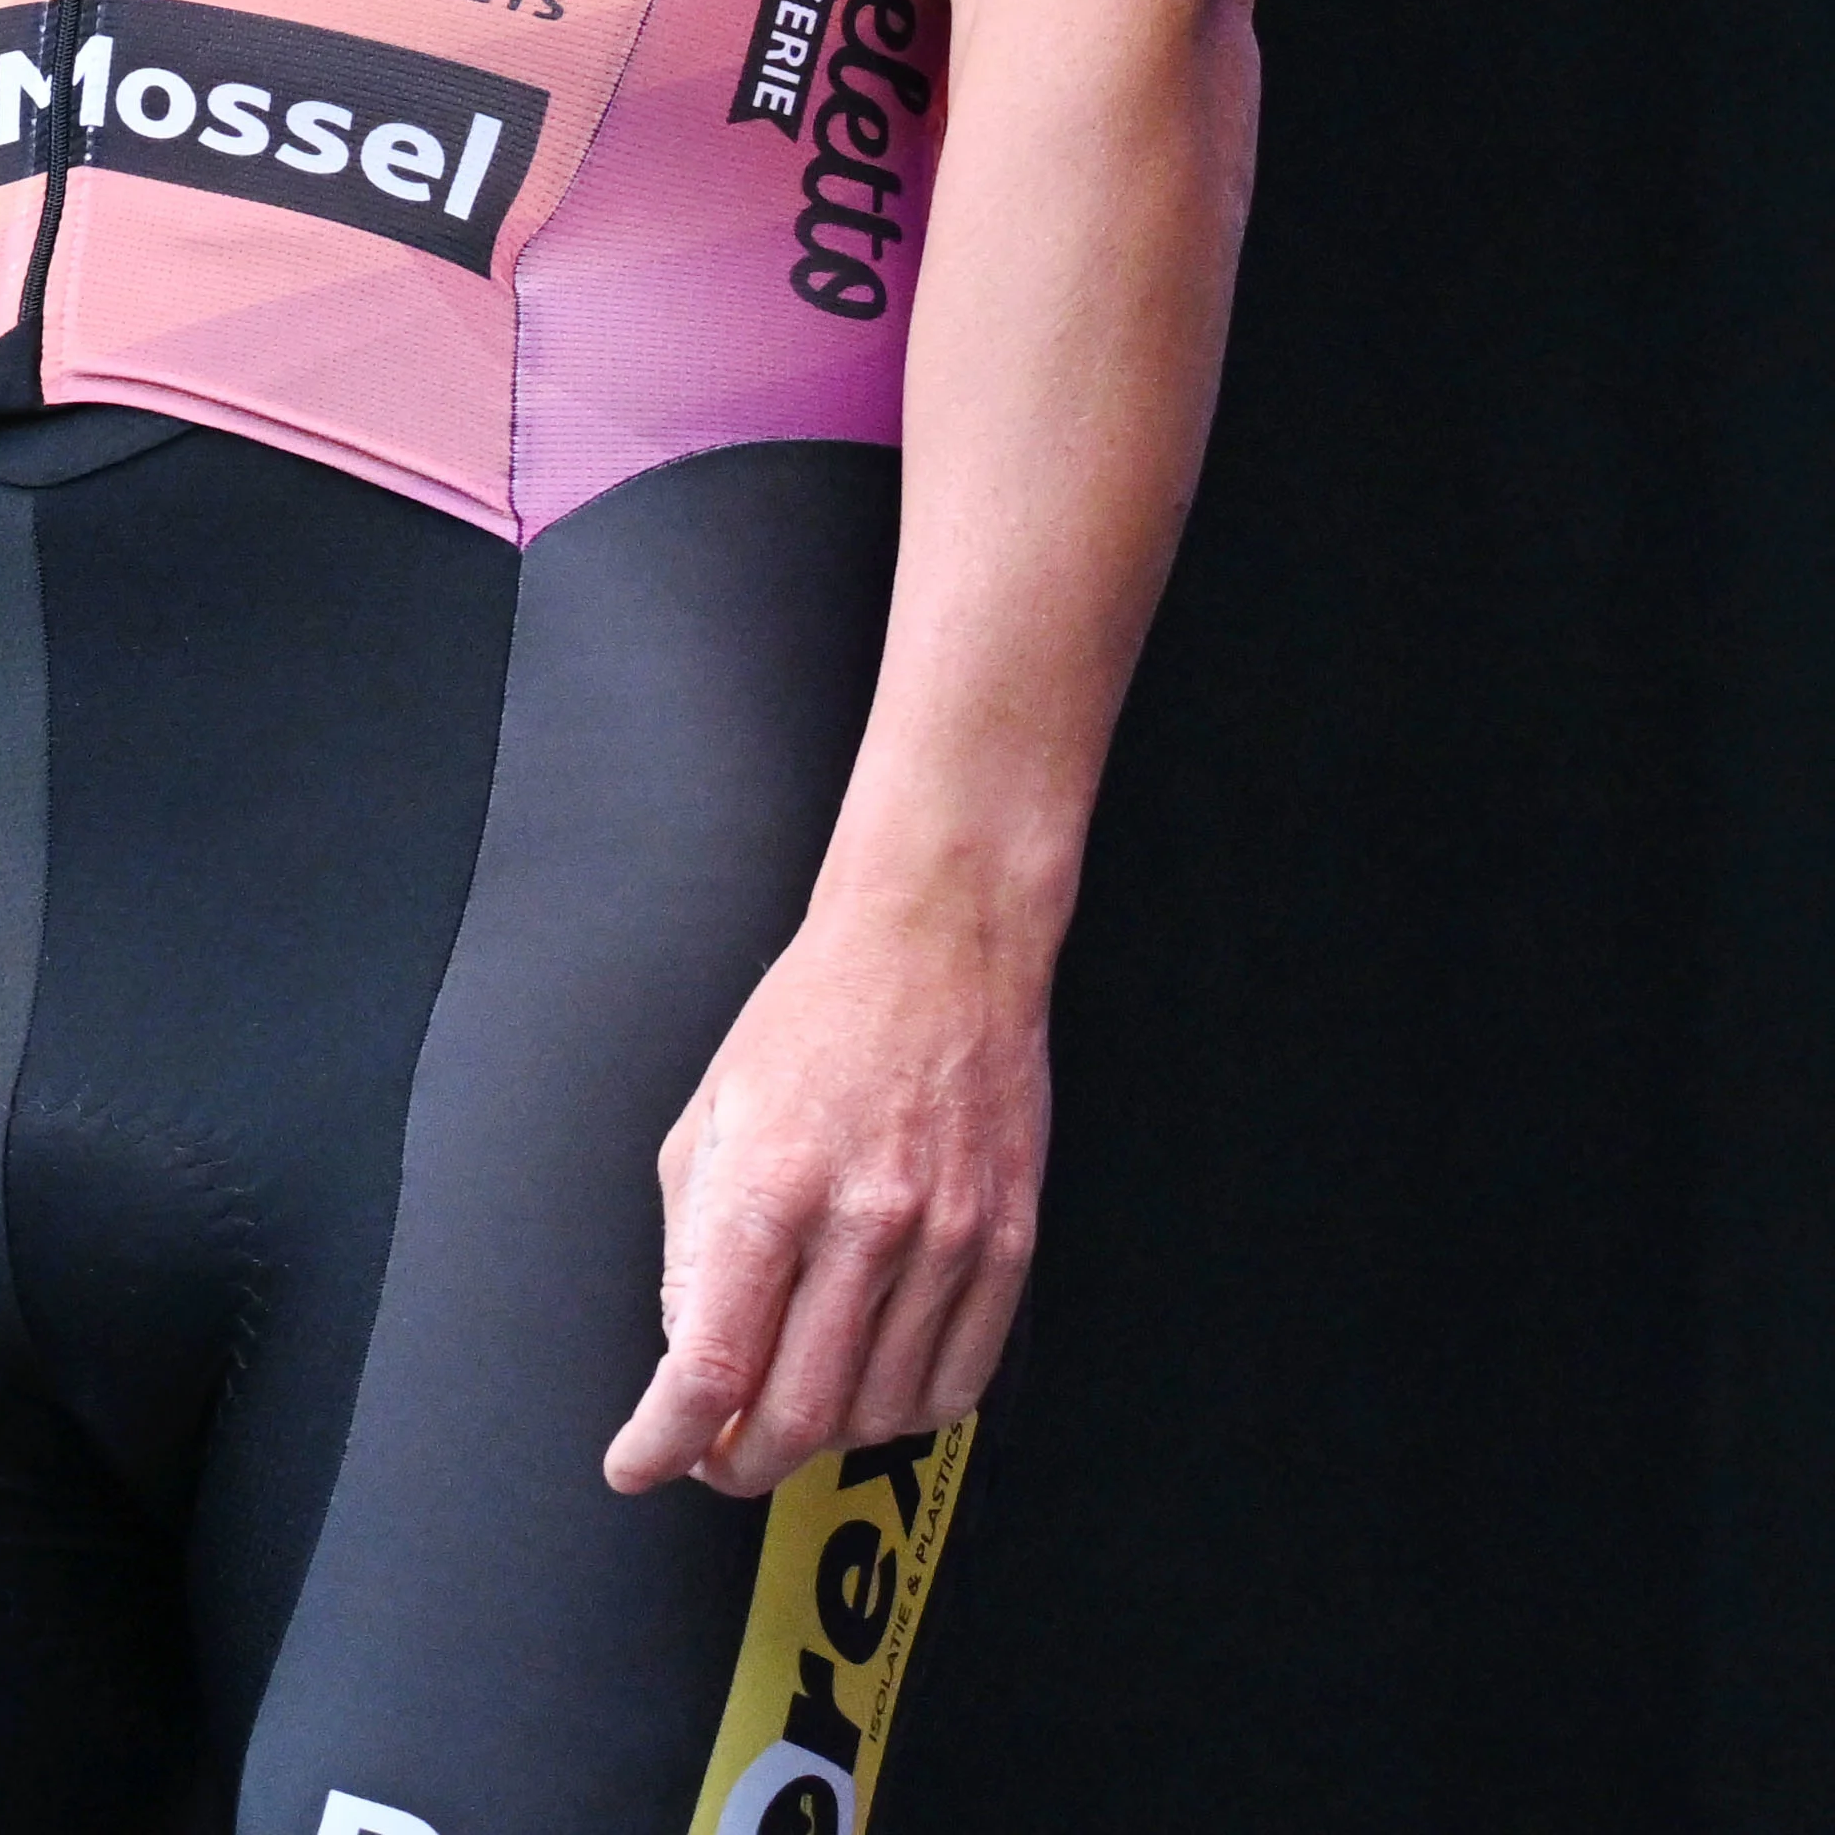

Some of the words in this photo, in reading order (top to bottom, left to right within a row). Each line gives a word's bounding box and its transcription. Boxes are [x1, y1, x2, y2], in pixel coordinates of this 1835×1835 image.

[867, 1604, 912, 1743] ISOLATIE
[907, 1573, 922, 1596] &
[915, 1421, 964, 1565] PLASTICS
